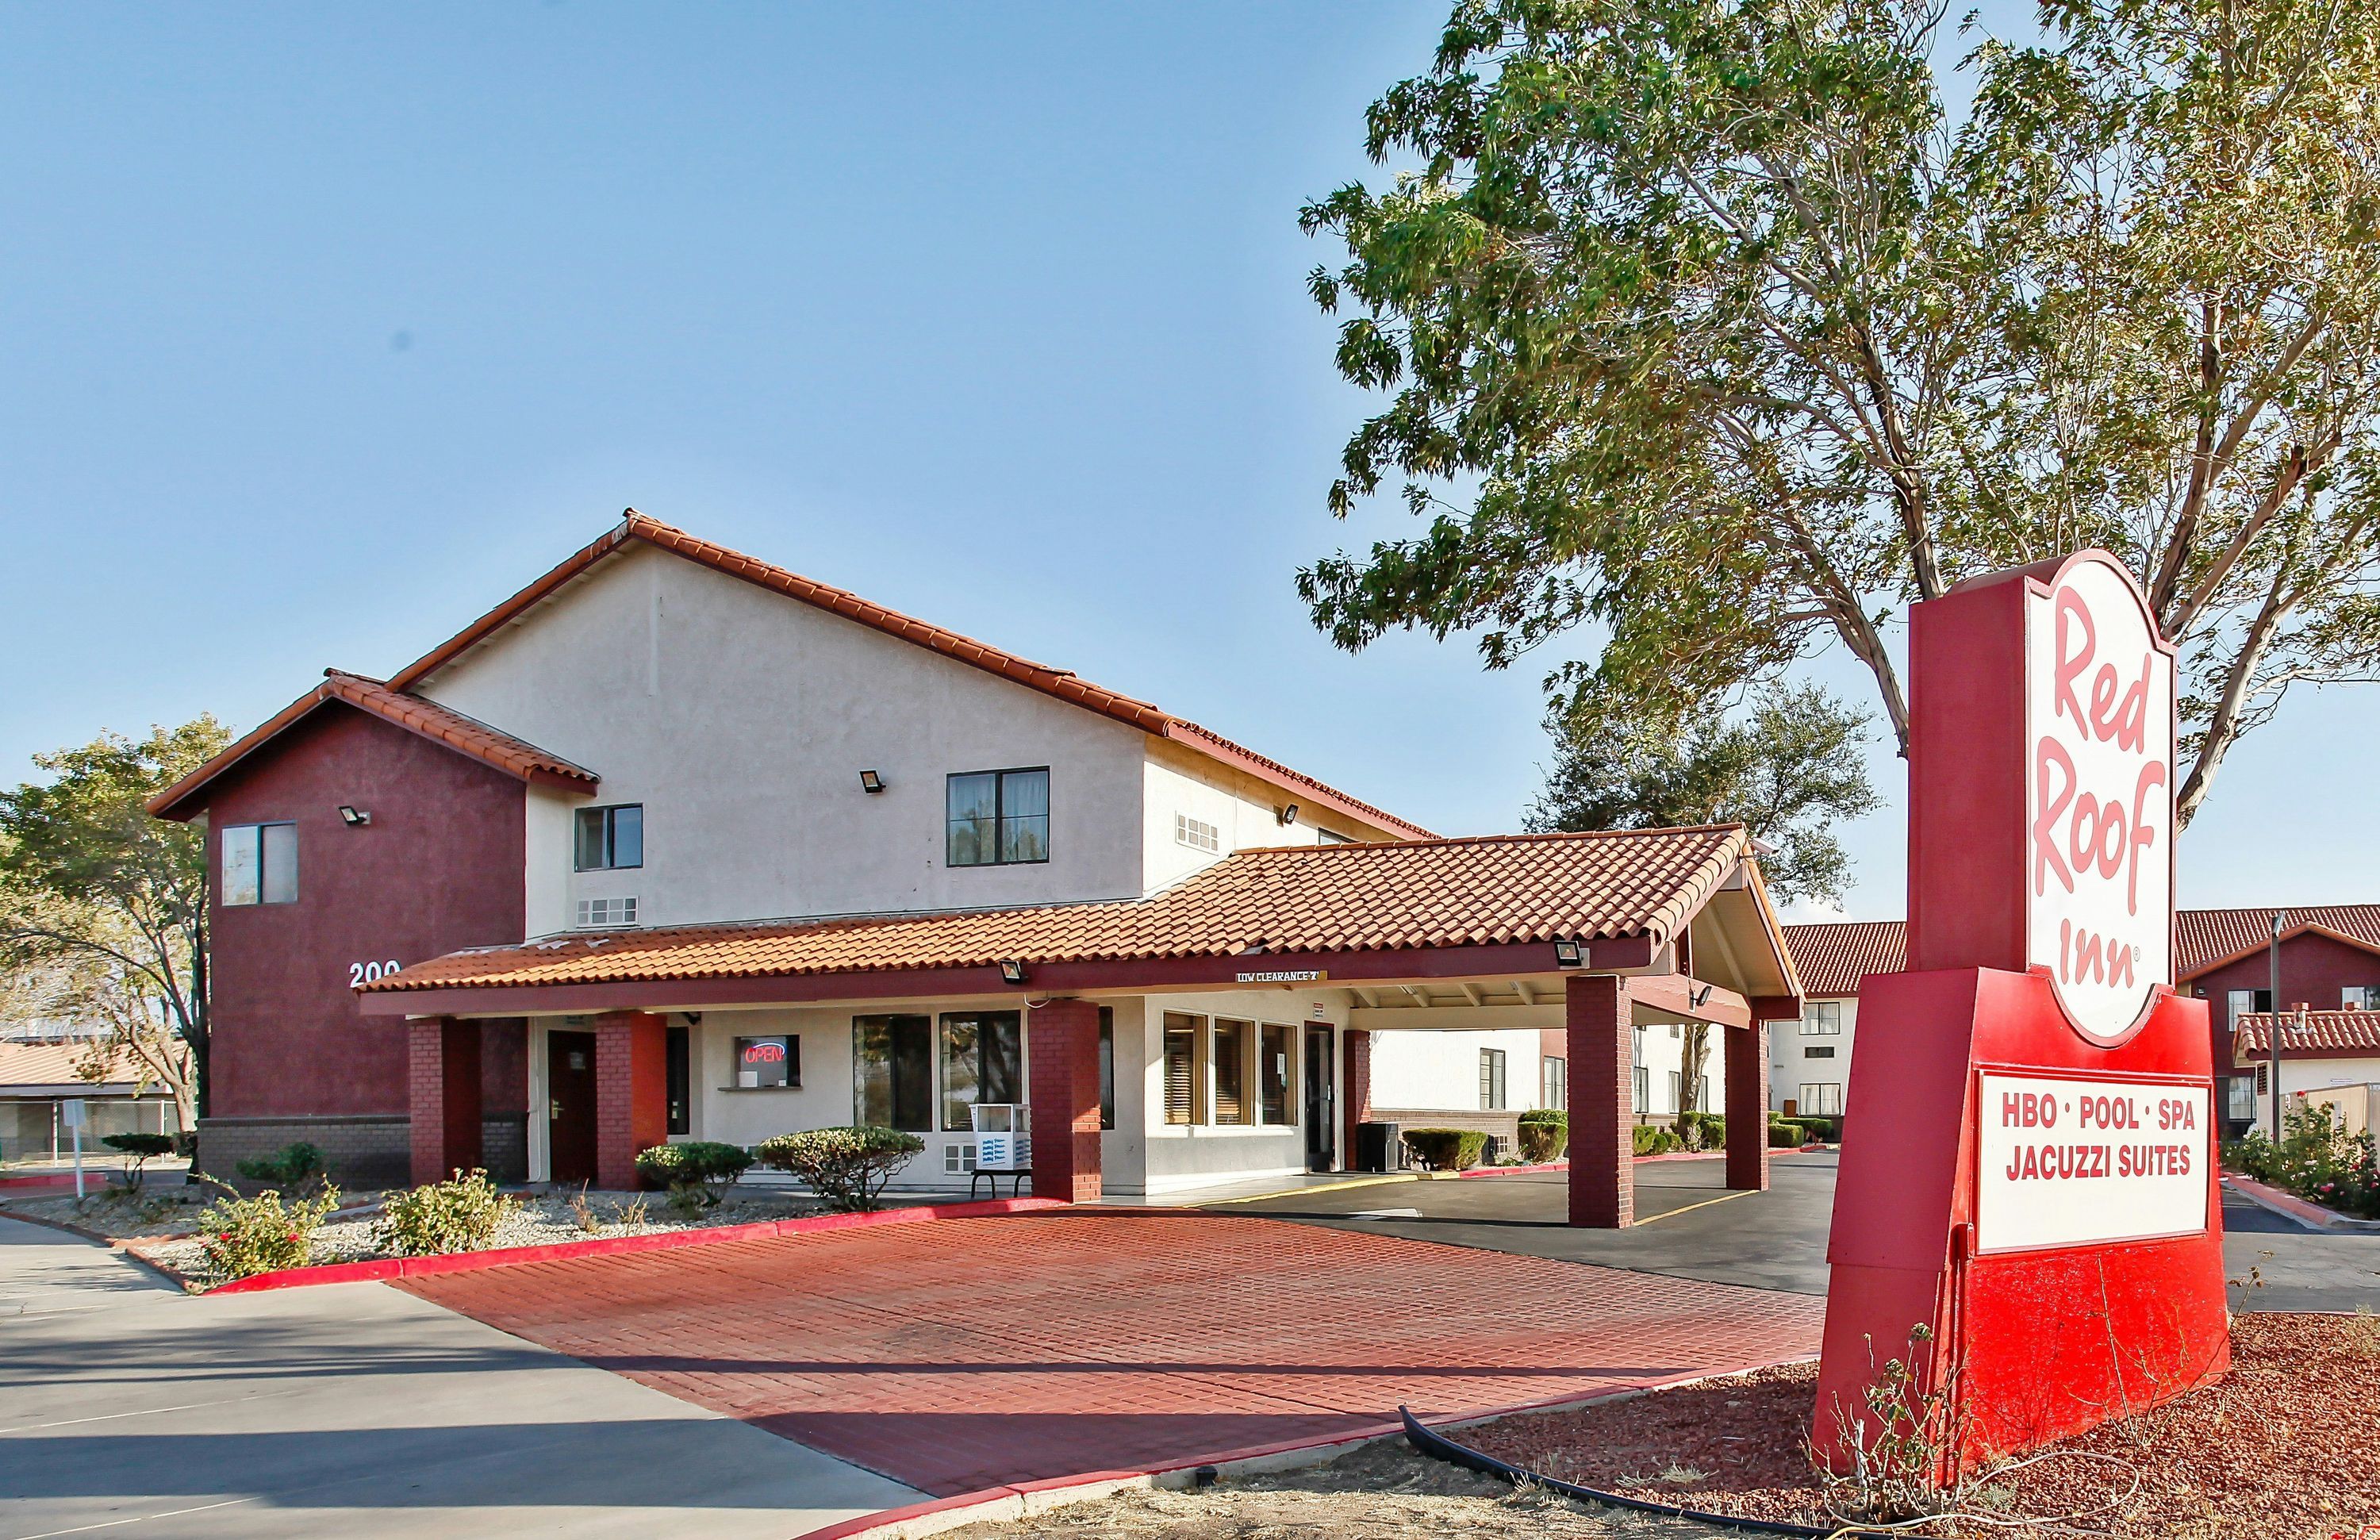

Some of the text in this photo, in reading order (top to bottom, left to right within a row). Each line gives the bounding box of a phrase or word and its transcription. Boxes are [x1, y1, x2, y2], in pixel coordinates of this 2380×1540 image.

[2056, 586, 2151, 755] Red
[2033, 735, 2166, 916] Roof
[349, 959, 401, 989] 200
[1237, 973, 1255, 982] LOW
[745, 1046, 783, 1064] OPEN
[2002, 1092, 2195, 1131] HBO POOL SPA
[2006, 1144, 2190, 1181] JACUZZI SUITES
